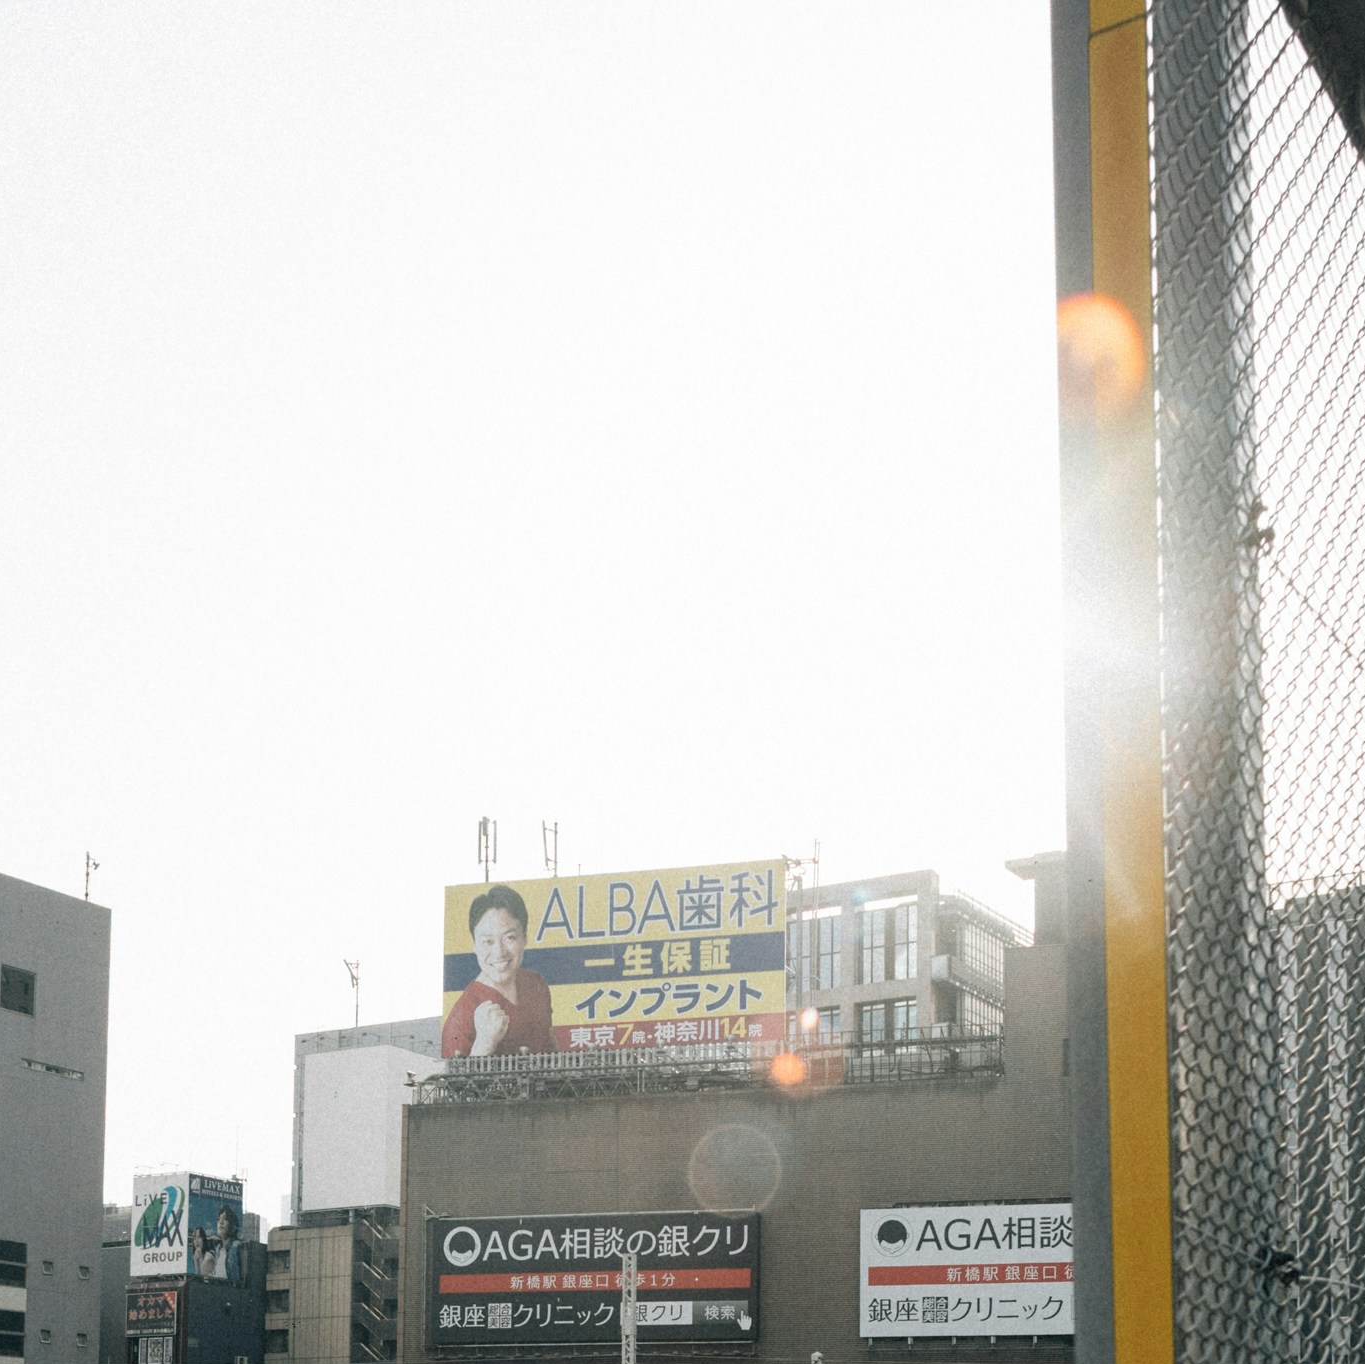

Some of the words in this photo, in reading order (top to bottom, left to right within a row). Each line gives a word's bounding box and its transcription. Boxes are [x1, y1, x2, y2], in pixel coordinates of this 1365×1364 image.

[536, 869, 779, 942] ALBA歯科
[584, 938, 731, 977] 一生保証
[574, 977, 763, 1021] インプラント
[142, 1209, 184, 1249] MAX
[482, 1224, 749, 1262] AGA相談の銀クリ
[916, 1215, 1074, 1251] AGA相談
[143, 1251, 183, 1263] GROUP
[946, 1266, 998, 1282] 新橋駅
[1005, 1265, 1057, 1280] 銀座口
[510, 1276, 557, 1289] 新橋駅
[562, 1275, 609, 1288] 銀座口
[128, 1309, 173, 1320] 始めました
[704, 1304, 736, 1320] 検索
